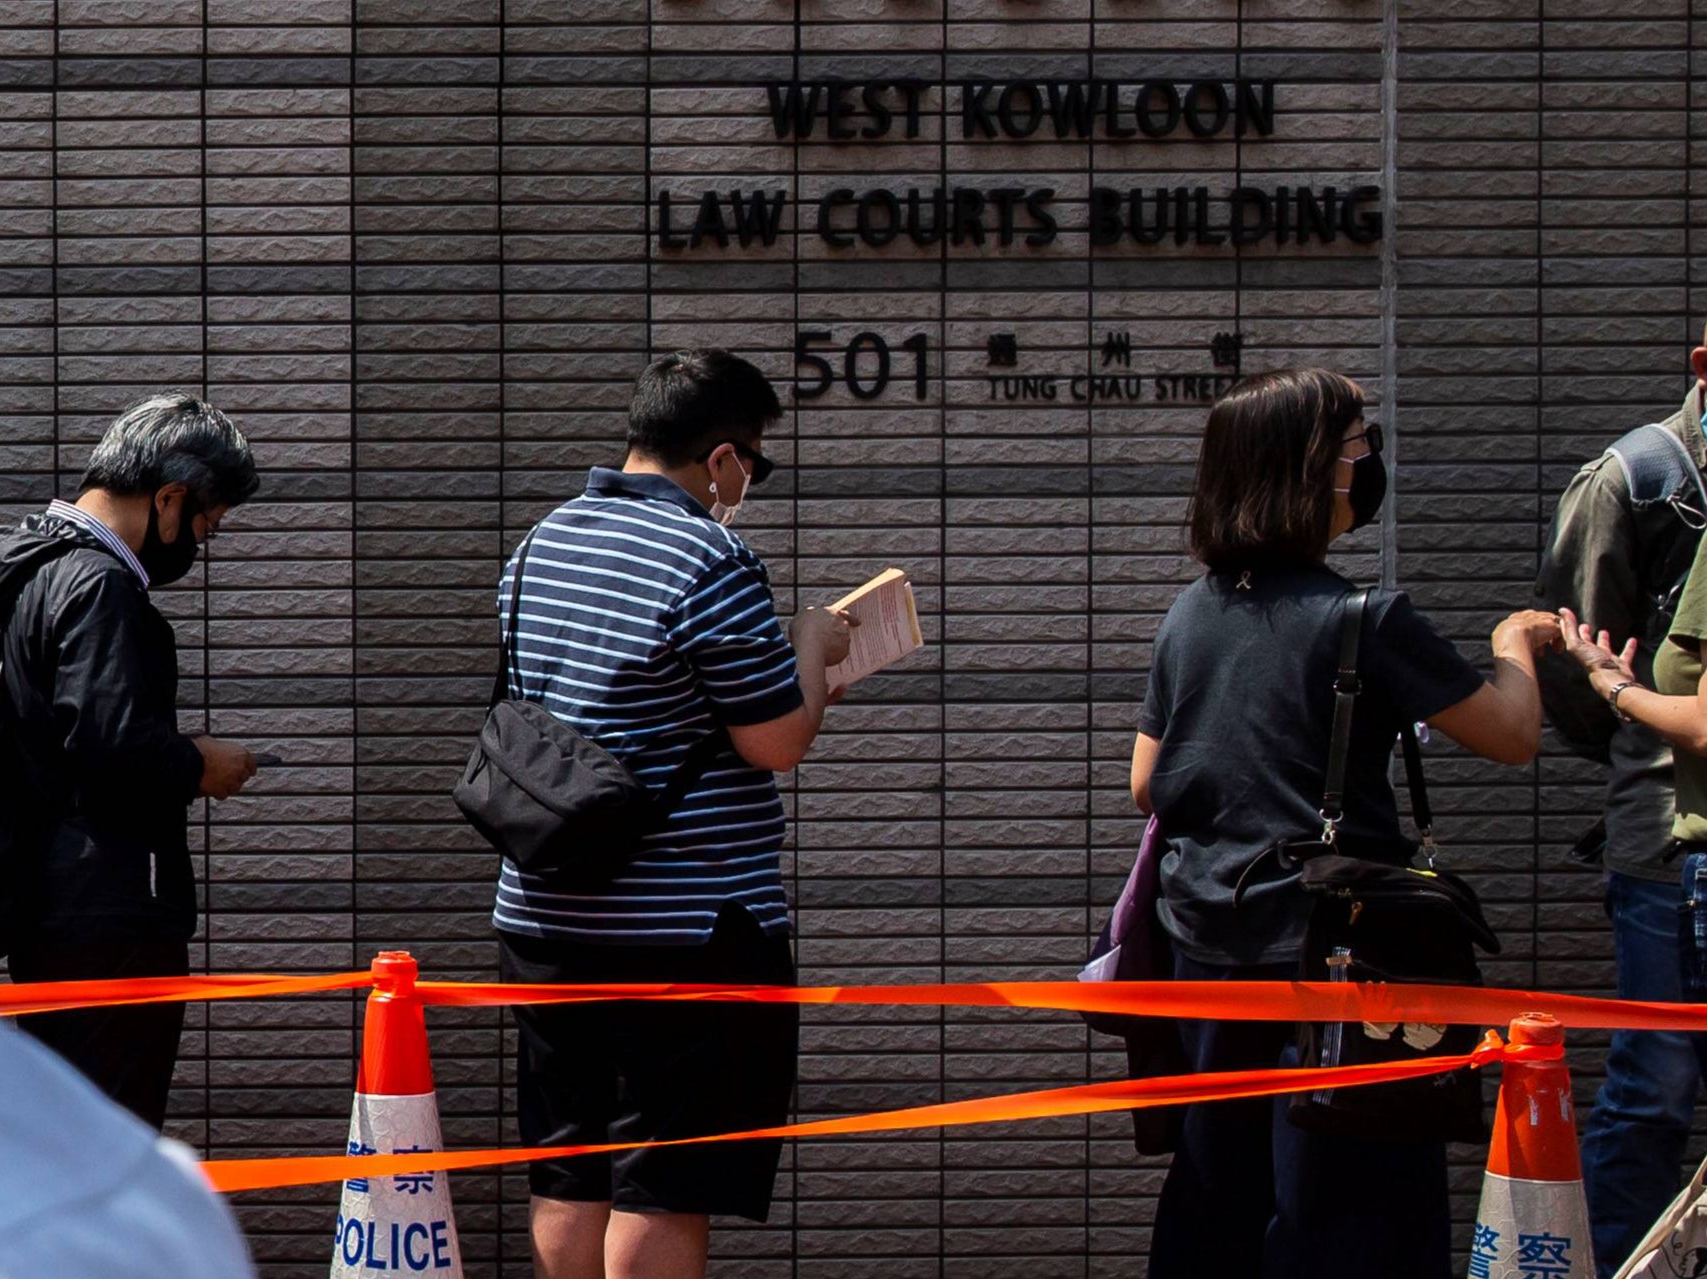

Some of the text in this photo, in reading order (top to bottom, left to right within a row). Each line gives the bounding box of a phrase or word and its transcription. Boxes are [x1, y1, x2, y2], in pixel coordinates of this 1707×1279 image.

[766, 77, 1274, 138] WEST KOWLOON
[658, 185, 1383, 250] LAW COURTS BUILDING
[794, 331, 928, 401] 501
[988, 377, 1057, 400] TUNG
[1071, 377, 1141, 400] CHAU
